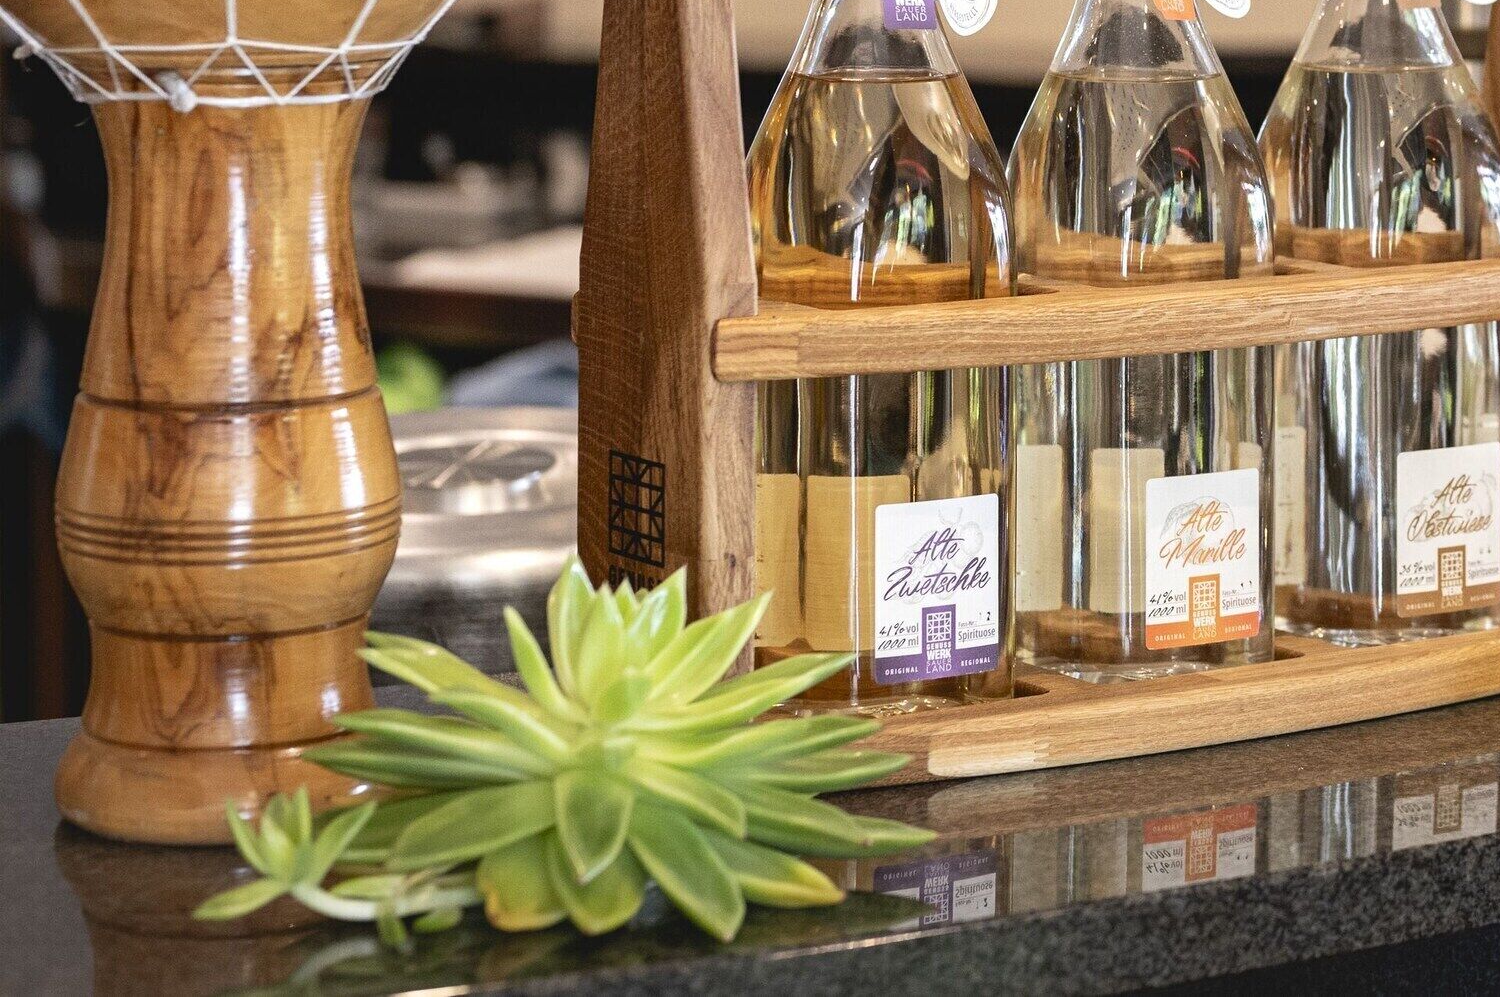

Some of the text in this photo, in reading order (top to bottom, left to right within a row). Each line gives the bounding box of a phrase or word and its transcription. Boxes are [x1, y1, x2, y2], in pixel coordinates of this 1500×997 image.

[895, 5, 927, 13] SAUER
[896, 12, 928, 22] LAND
[1430, 474, 1477, 508] Alte
[1176, 501, 1228, 536] Alte
[908, 527, 965, 565] Alte
[1159, 528, 1247, 569] Marille
[883, 557, 991, 601] Zwetschke
[1174, 591, 1186, 602] vol
[1222, 595, 1257, 610] Spirituose
[1148, 606, 1174, 617] 1000
[1193, 616, 1217, 628] WERK
[906, 623, 919, 634] vol
[958, 627, 996, 643] Spirituose
[878, 636, 919, 651] 1000 ml
[926, 642, 952, 651] GENUSS
[926, 649, 952, 661] WERK
[926, 658, 952, 666] SAUER
[961, 657, 991, 667] REGIONAL
[885, 666, 919, 676] ORIGINAL
[926, 664, 953, 674] LAND
